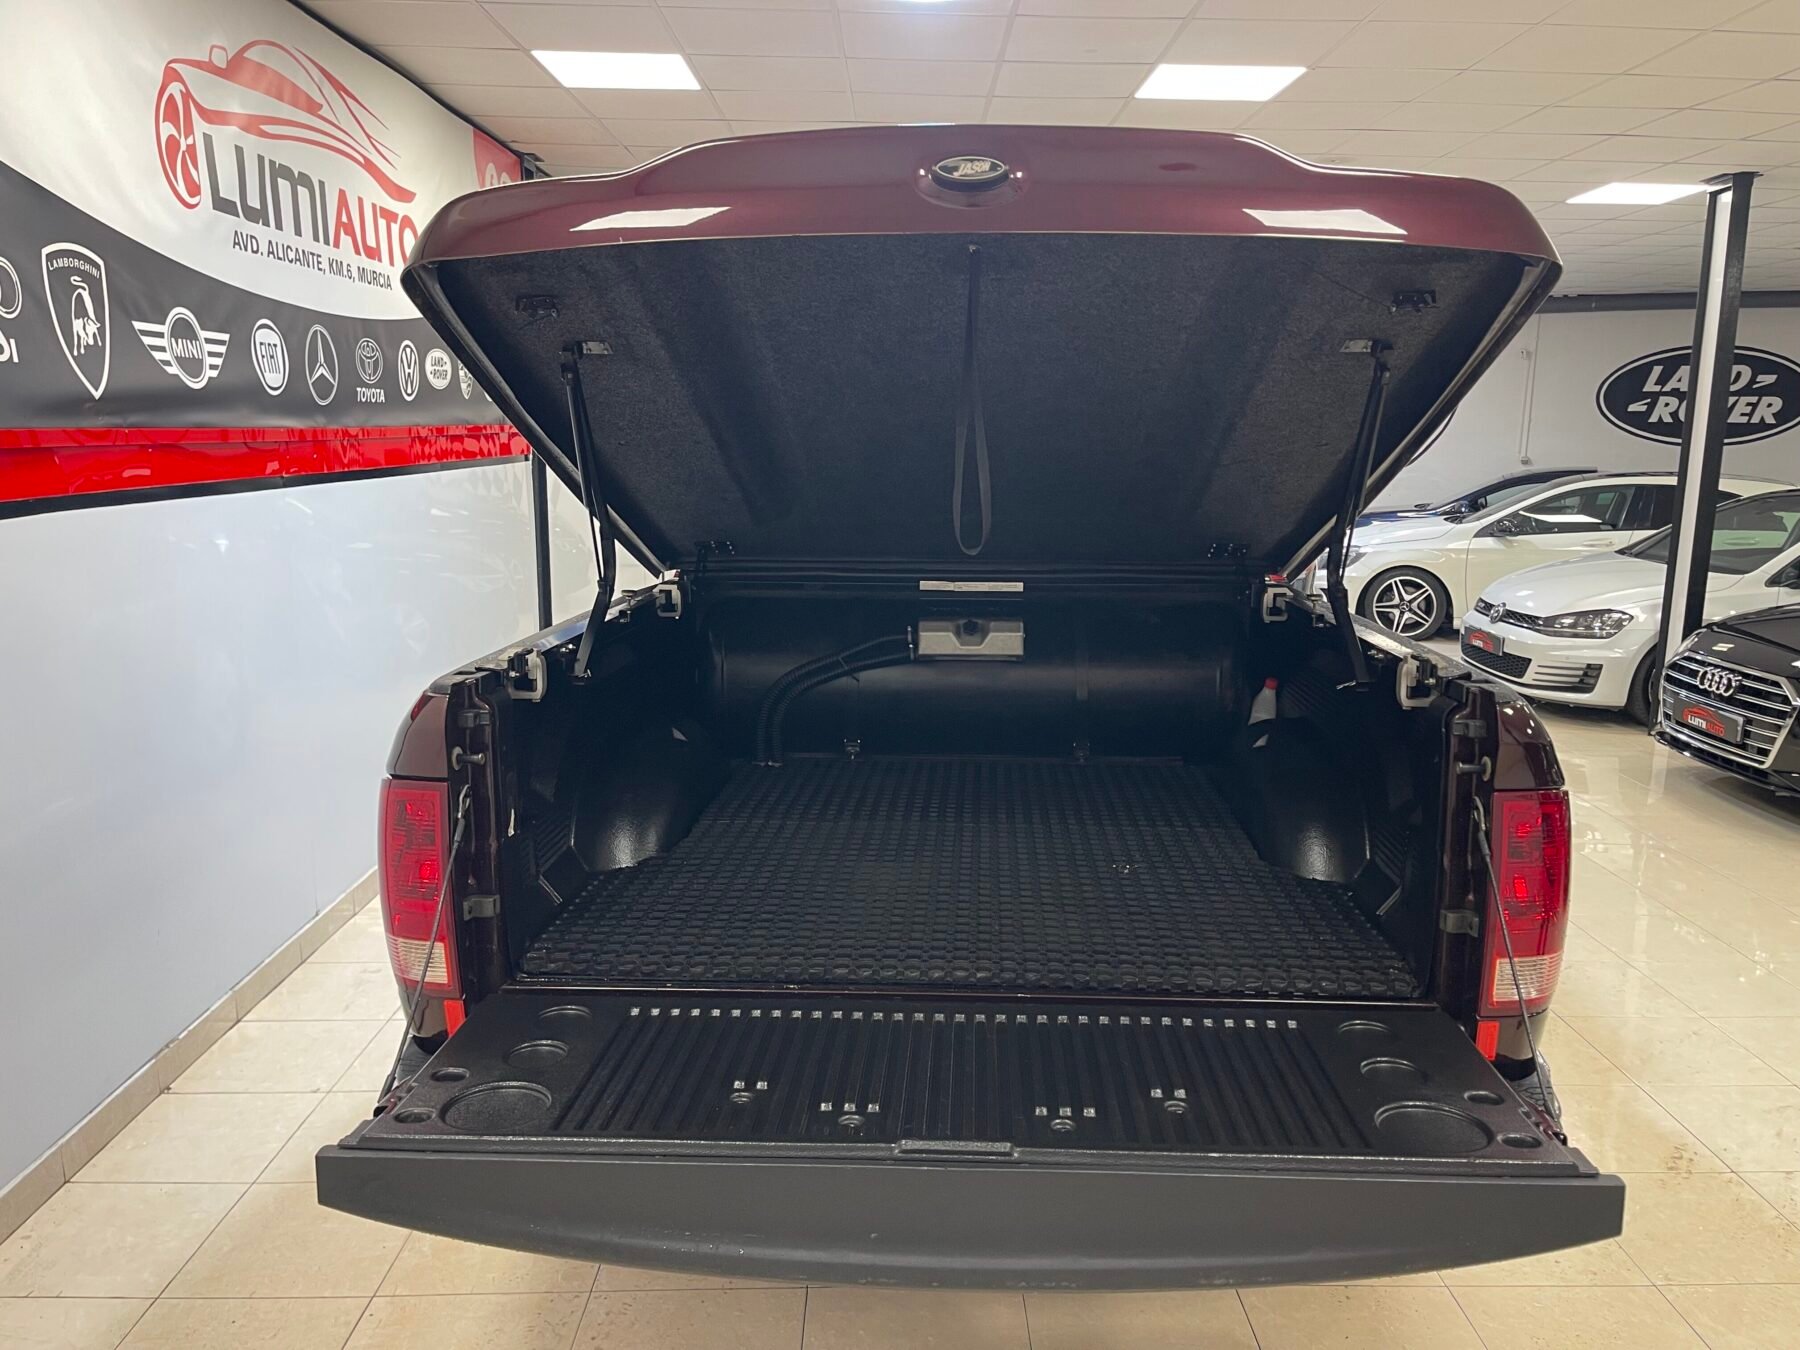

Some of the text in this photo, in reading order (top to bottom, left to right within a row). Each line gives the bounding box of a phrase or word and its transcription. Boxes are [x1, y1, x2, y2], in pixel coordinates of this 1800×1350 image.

[48, 257, 101, 279] LAMBORGHINI
[232, 229, 393, 291] AVD. ALICANTE, KM.6, MURCIA
[171, 337, 203, 360] MINI
[258, 341, 281, 375] FIAT
[1642, 365, 1752, 392] LAD
[356, 387, 386, 403] TOYOTA
